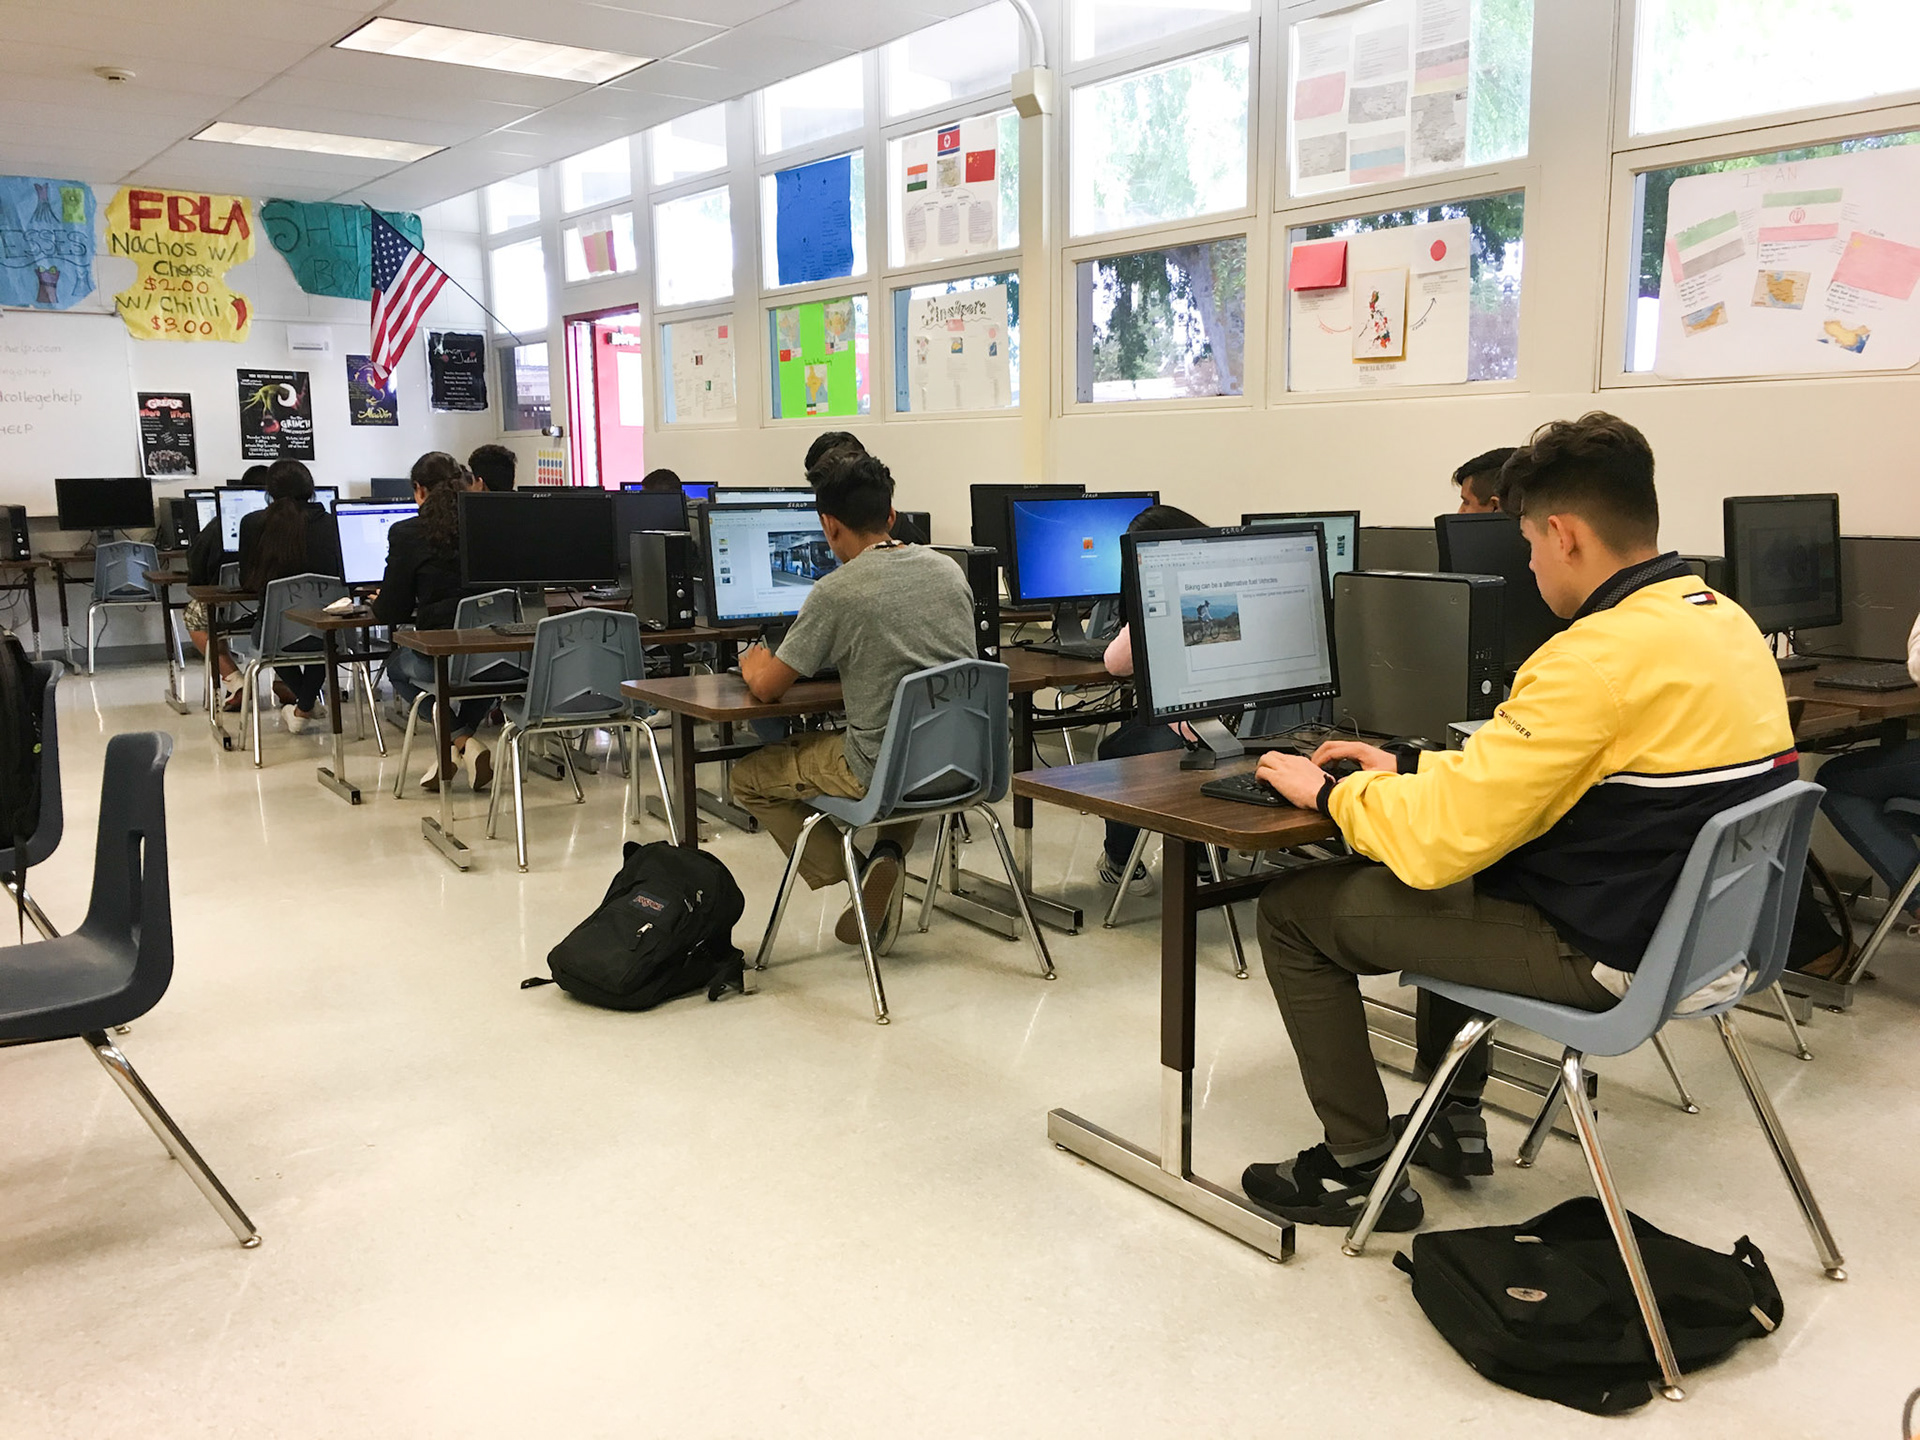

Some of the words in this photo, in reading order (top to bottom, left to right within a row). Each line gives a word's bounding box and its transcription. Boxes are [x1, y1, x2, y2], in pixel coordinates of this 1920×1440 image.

[128, 189, 250, 240] FBLA
[112, 232, 197, 257] Nachos
[153, 260, 213, 277] Cheese
[313, 258, 371, 296] BOY
[144, 276, 209, 294] $2.00
[160, 296, 219, 317] Chilli
[151, 315, 213, 335] $3.00
[280, 419, 311, 429] GRINCH
[287, 580, 329, 604] ROP
[556, 616, 619, 648] ROP
[925, 666, 981, 710] ROP
[1504, 713, 1532, 739] HILFIGER
